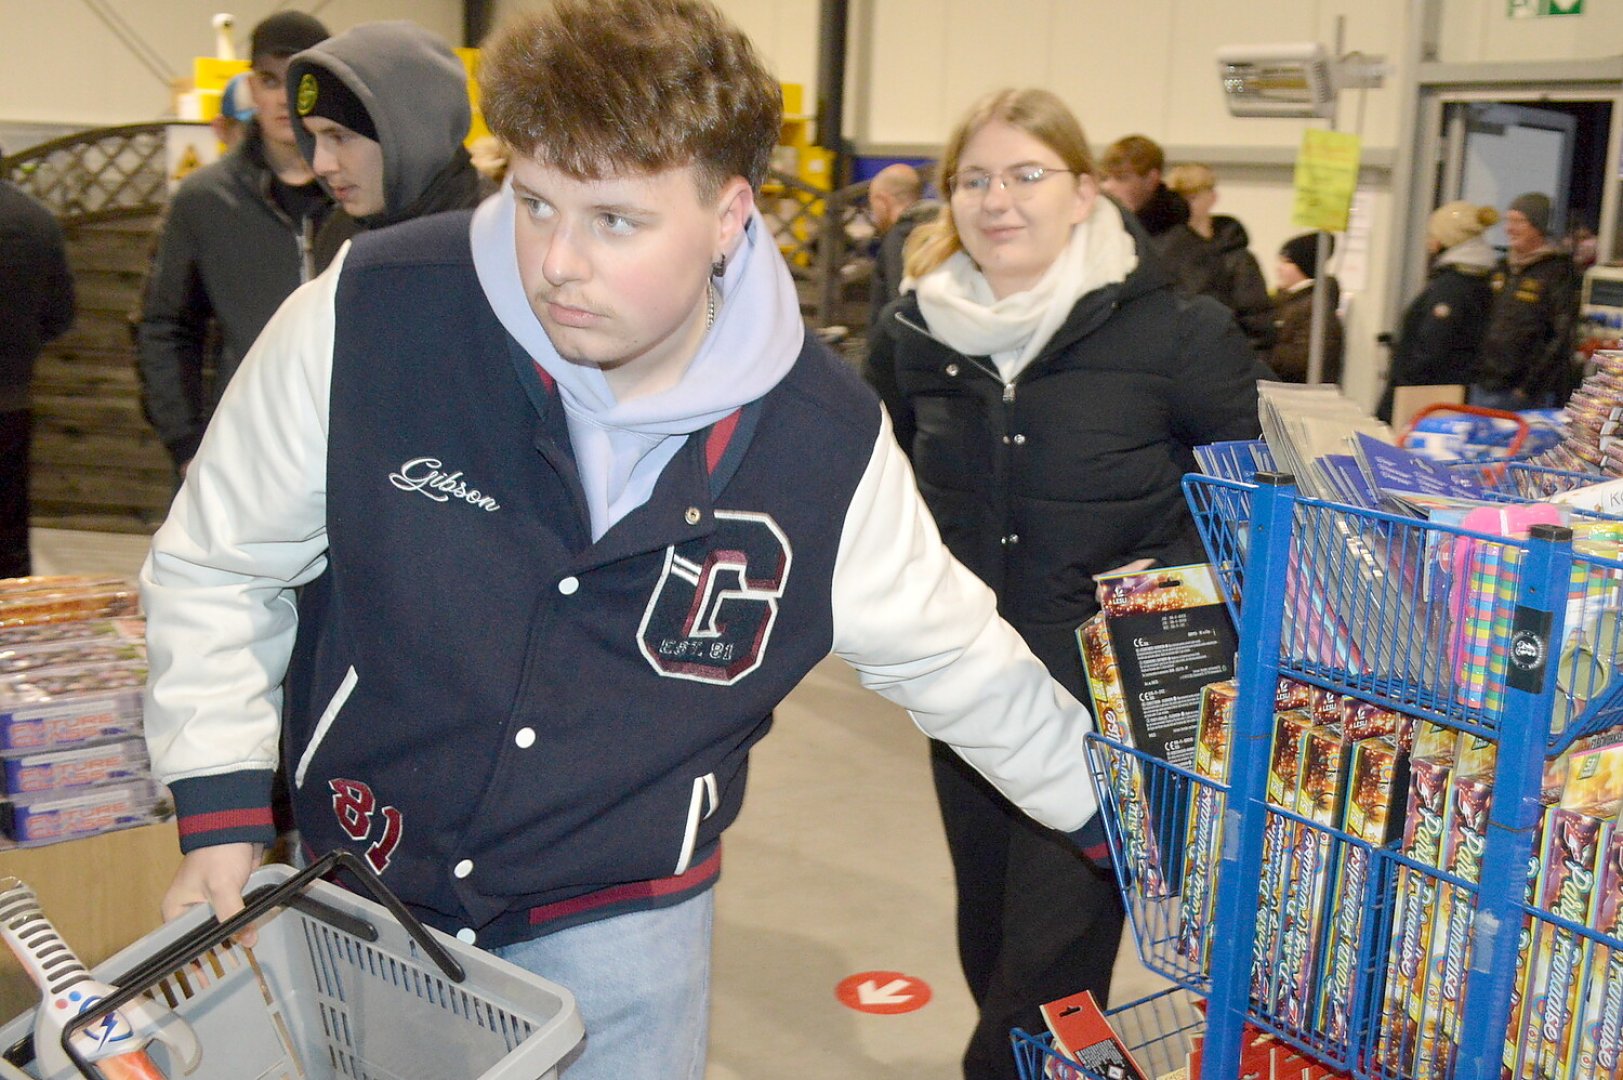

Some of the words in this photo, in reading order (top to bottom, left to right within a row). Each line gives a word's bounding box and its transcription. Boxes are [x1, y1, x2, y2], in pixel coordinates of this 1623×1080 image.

[388, 457, 500, 511] Gibson
[659, 639, 703, 657] EST.
[328, 778, 402, 876] 81
